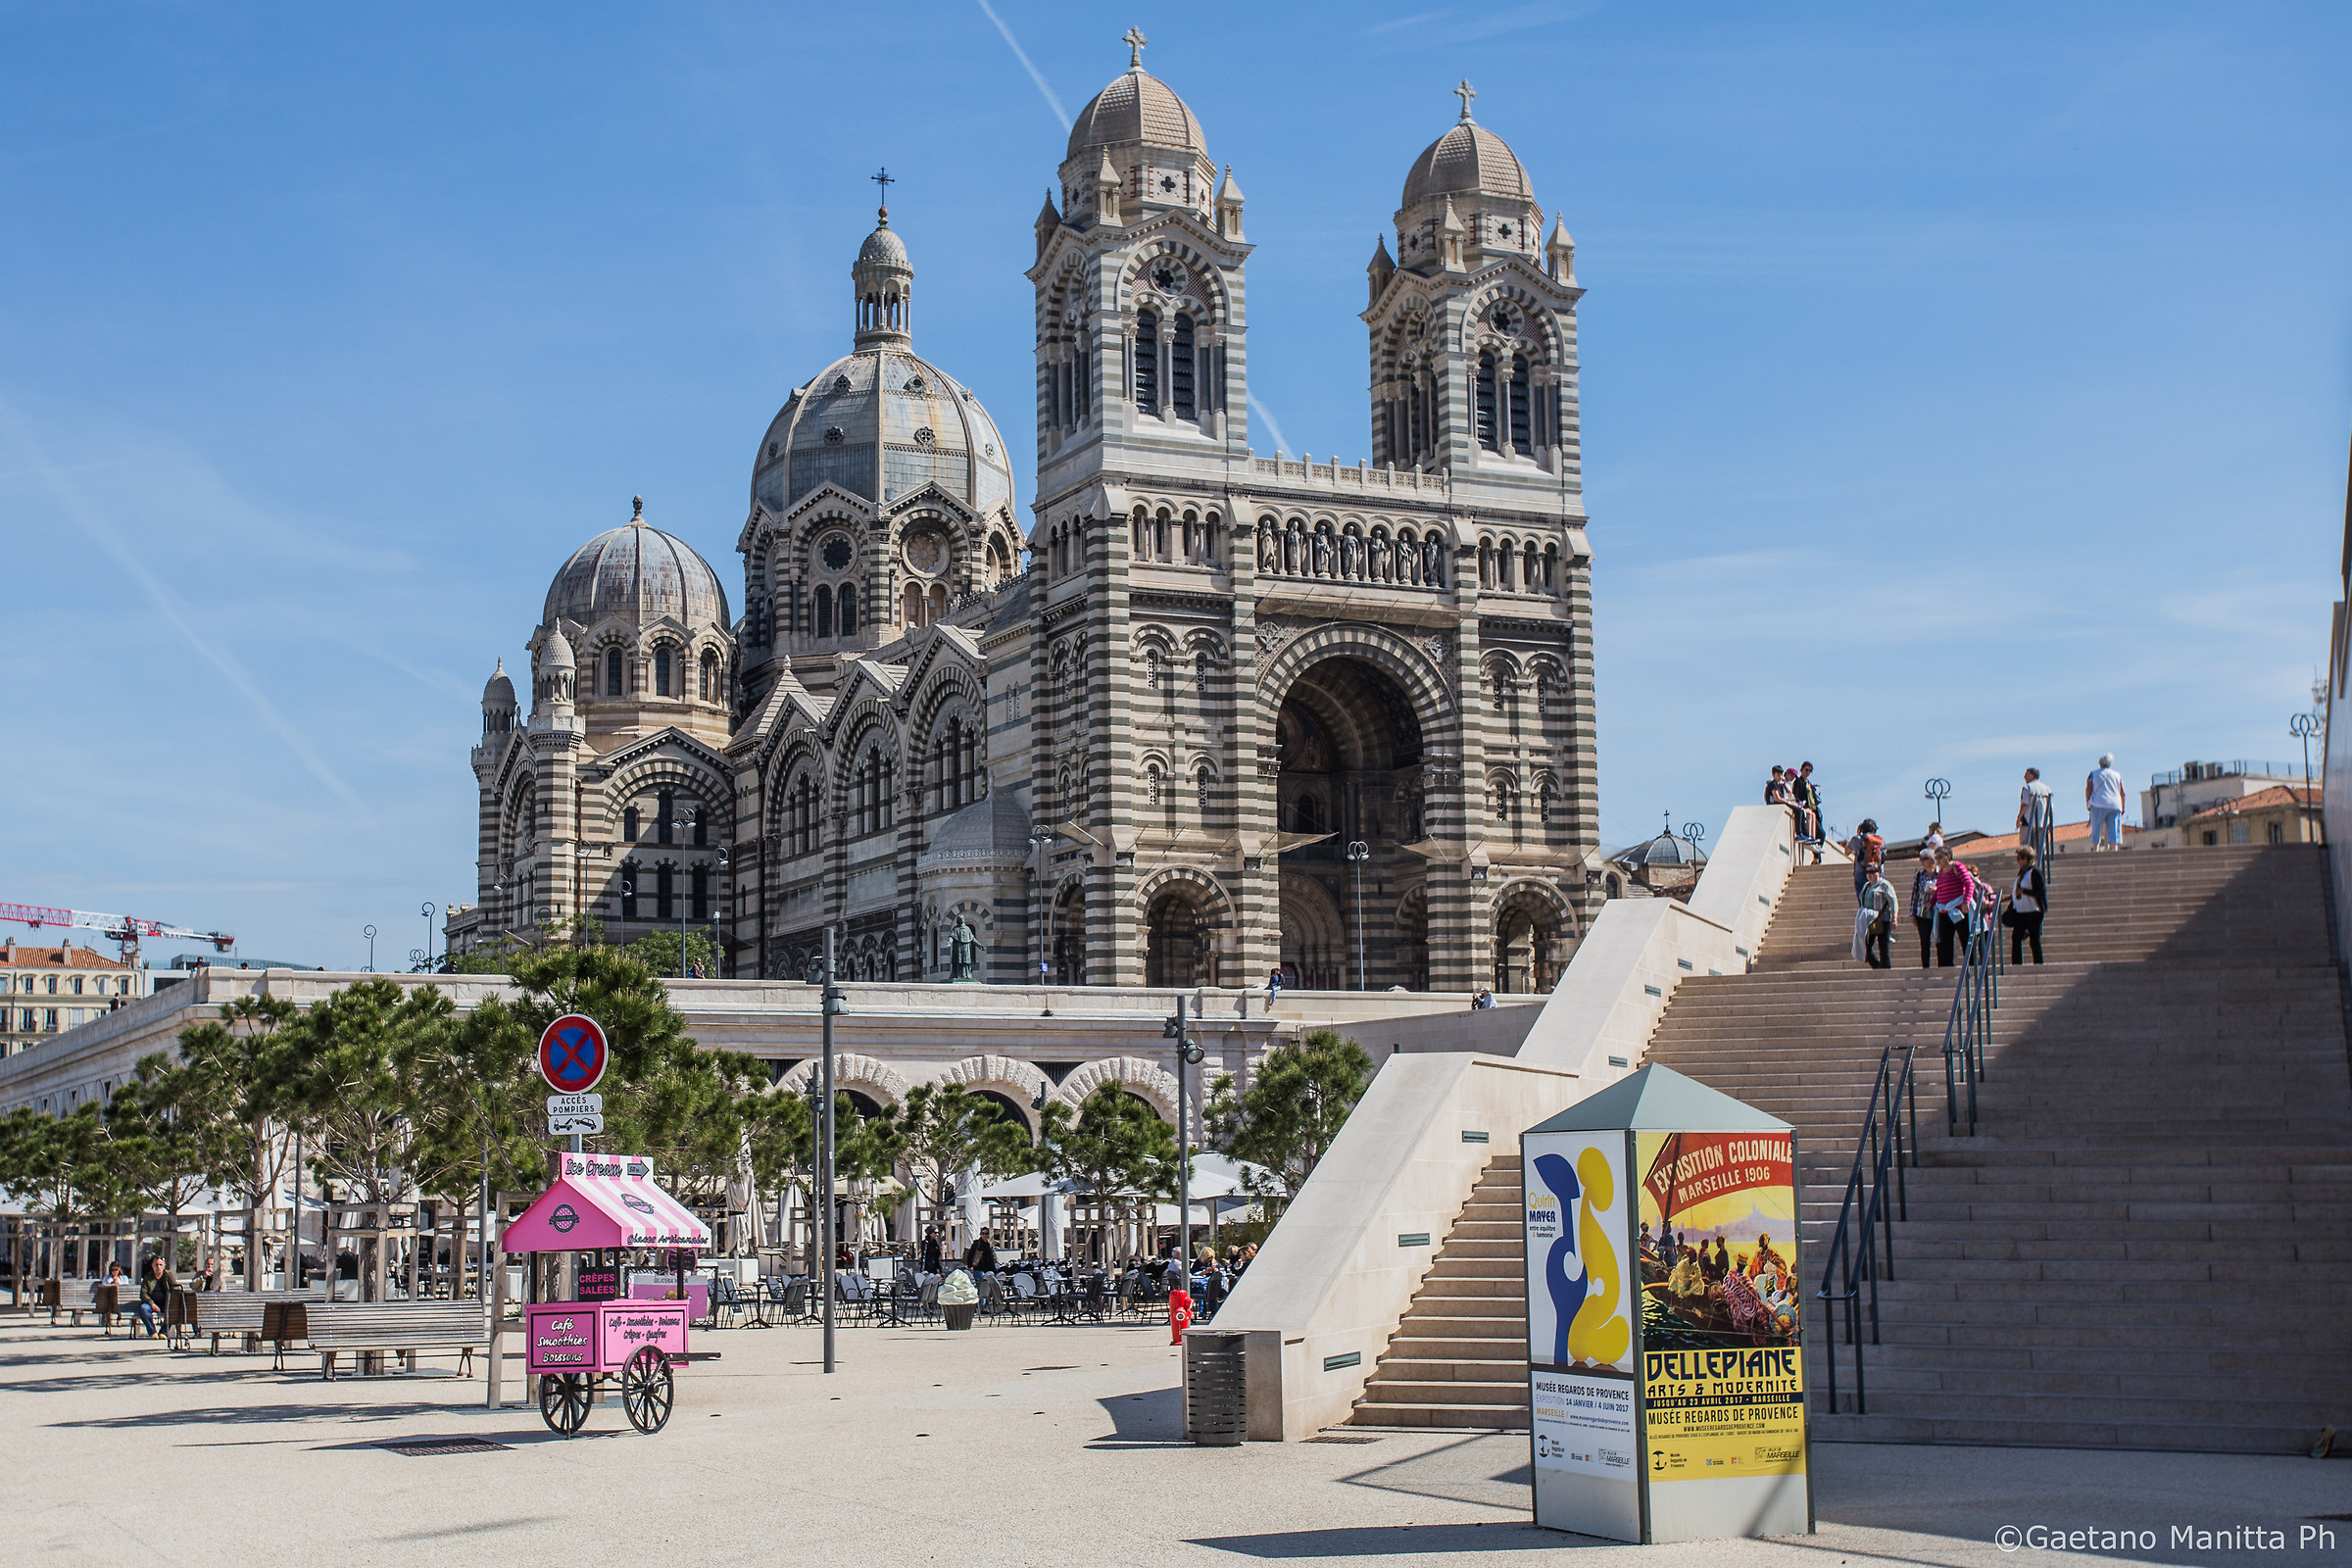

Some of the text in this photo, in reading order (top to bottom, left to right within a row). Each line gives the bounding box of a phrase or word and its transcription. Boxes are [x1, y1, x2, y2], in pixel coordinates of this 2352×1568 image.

[561, 1096, 586, 1104] ACCÈS
[564, 1158, 622, 1177] Ice Cream
[1653, 1139, 1792, 1194] EXPOSITION COLONIALE
[1678, 1166, 1770, 1203] MARSEILLE 1906
[1529, 1192, 1555, 1209] Quirin
[1529, 1210, 1555, 1222] MAYER
[627, 1233, 709, 1245] Glaces Artisanales
[579, 1273, 614, 1283] CRÊPES
[579, 1284, 614, 1295] SALÉES
[551, 1317, 574, 1337] Café
[536, 1333, 588, 1348] Smoothies
[543, 1350, 583, 1363] Boissons
[1646, 1349, 1795, 1382] DELLEPIANE
[1537, 1381, 1629, 1400] MUSÉE REGARDS DE PROVENCE
[1647, 1377, 1797, 1397] ARTS & MODERNITÉ
[1537, 1395, 1565, 1404] EXPOSITION
[1573, 1398, 1593, 1408] JANVIER
[1615, 1403, 1629, 1412] 2017
[1653, 1398, 1686, 1407] JUSQU'AU
[1701, 1396, 1722, 1405] AVRIL
[1537, 1407, 1564, 1417] MARSEILLE
[1648, 1406, 1798, 1425] MUSÉE REGARDS DE PROVENCE
[1607, 1455, 1630, 1464] MARSEILLE
